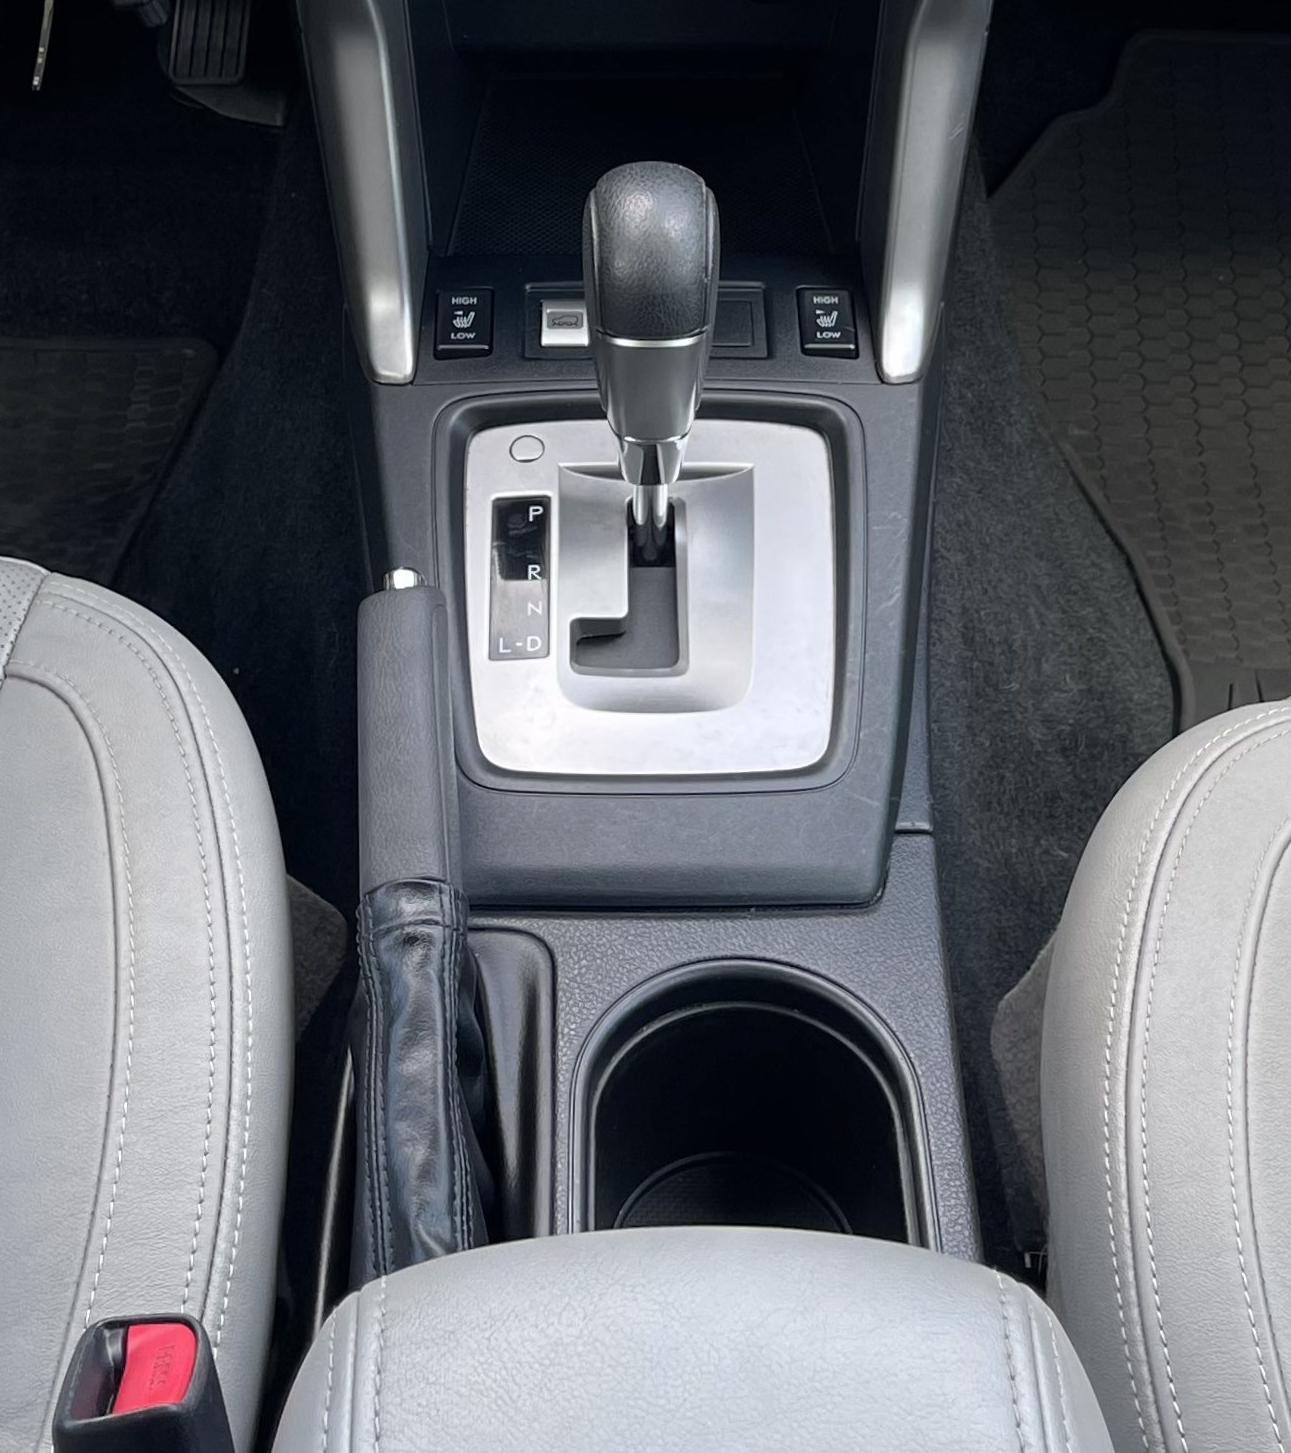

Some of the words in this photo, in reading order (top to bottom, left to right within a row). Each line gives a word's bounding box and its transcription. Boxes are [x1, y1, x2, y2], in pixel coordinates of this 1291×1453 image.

[451, 296, 477, 305] HIGH
[813, 295, 839, 304] HIGH
[528, 505, 544, 522] P
[527, 564, 542, 580] R
[527, 601, 543, 616] N
